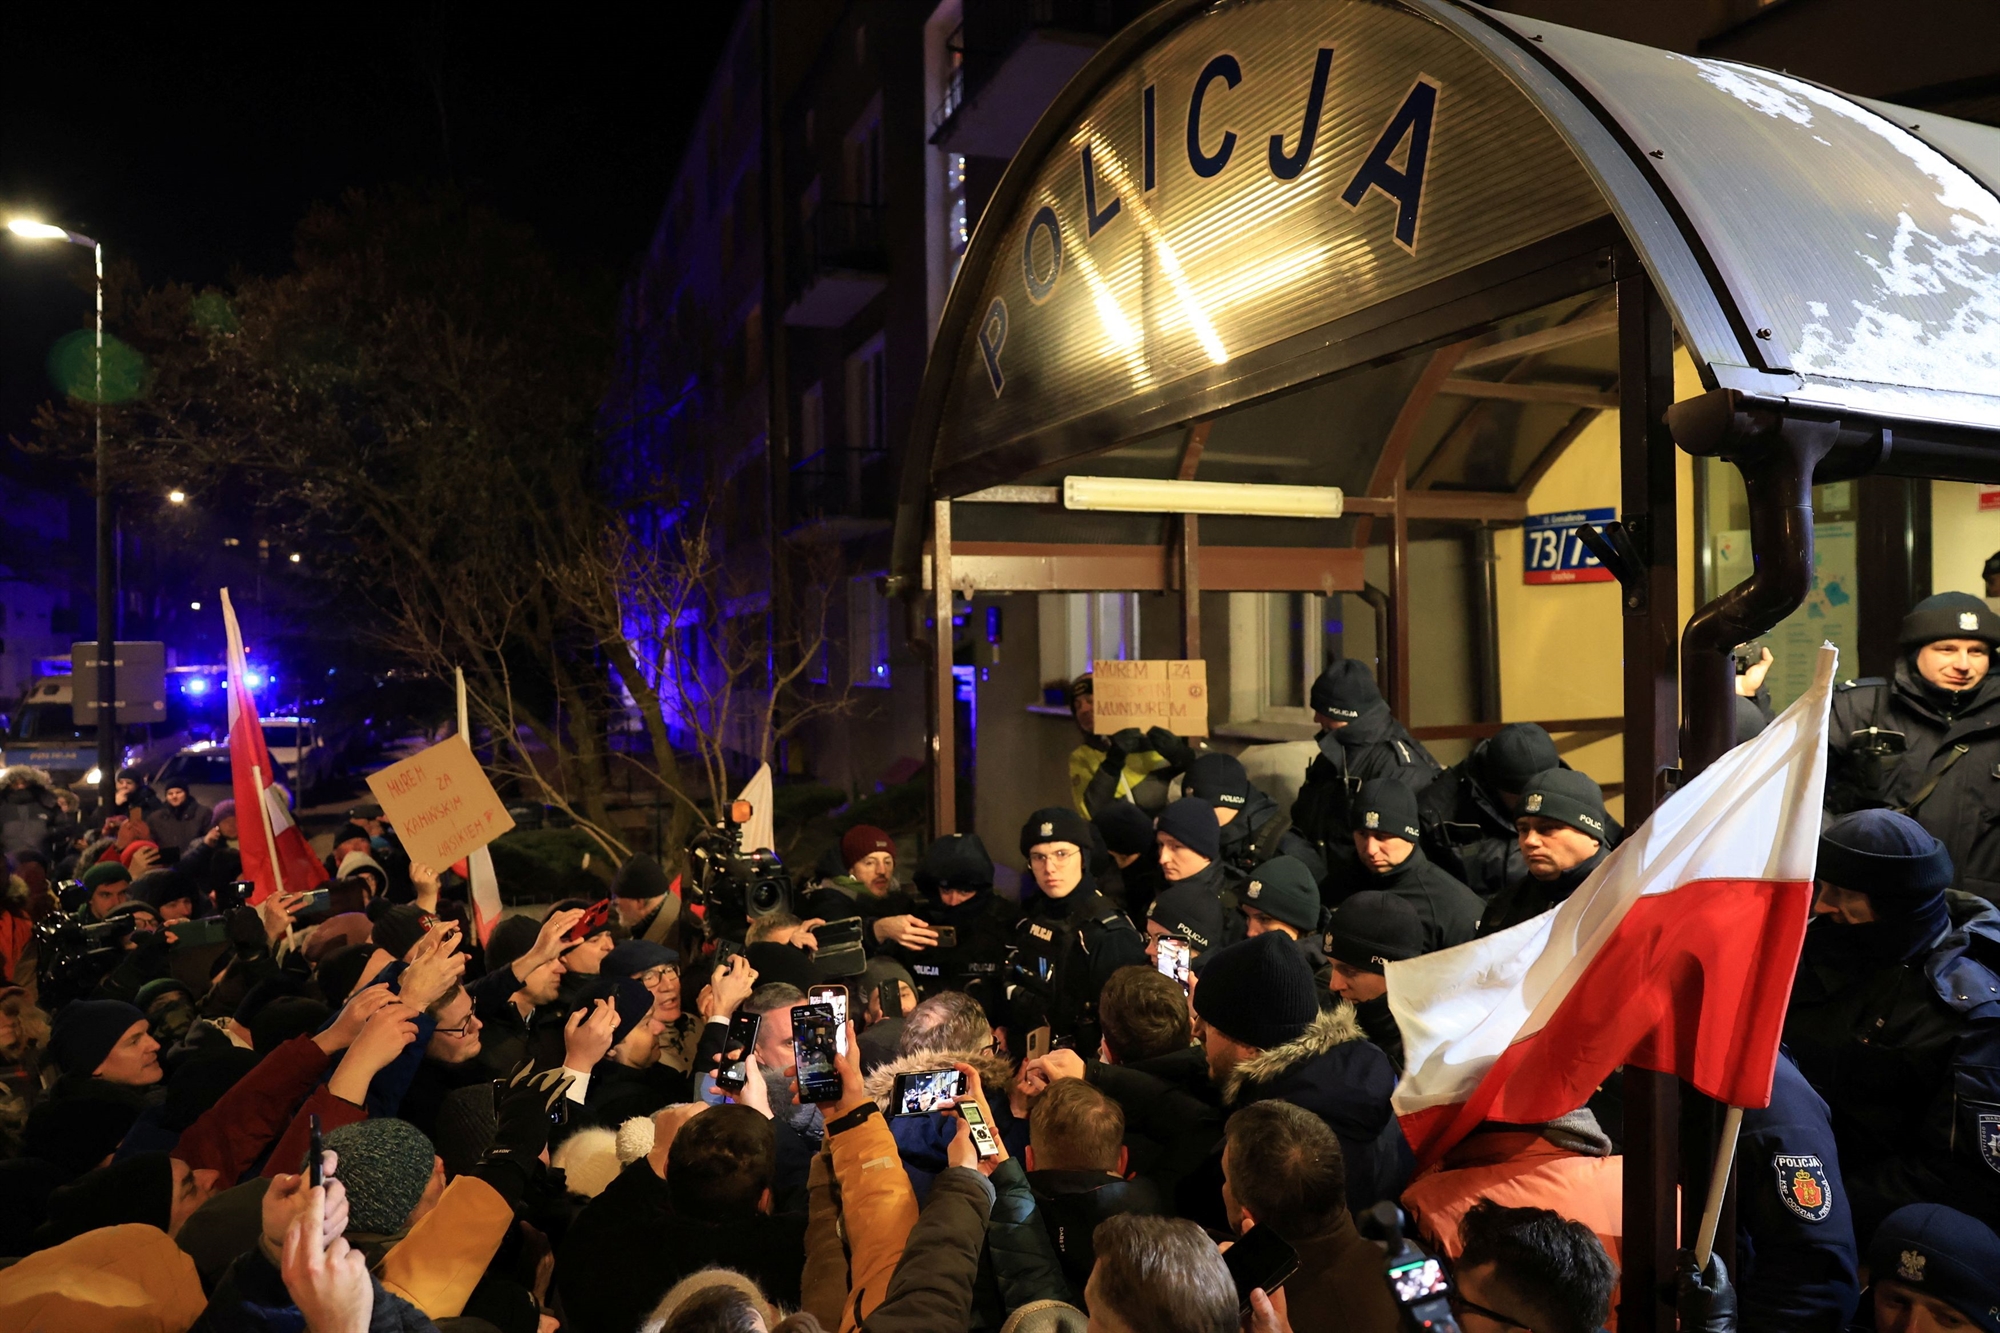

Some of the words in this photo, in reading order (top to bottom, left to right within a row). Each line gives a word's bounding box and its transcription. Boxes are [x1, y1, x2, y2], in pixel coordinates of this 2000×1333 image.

[977, 41, 1442, 399] POLICJA
[1094, 660, 1148, 679] MUREM
[1174, 663, 1191, 679] ZA
[1097, 700, 1187, 717] MUNDUREM
[386, 765, 427, 800] MUREM
[436, 772, 453, 792] ZA
[1579, 814, 1604, 832] POLIC
[1177, 922, 1209, 947] POLICJA
[1778, 1157, 1820, 1168] POLICJA
[1780, 1180, 1789, 1195] KSP
[1787, 1197, 1816, 1219] ODDZIAŁ
